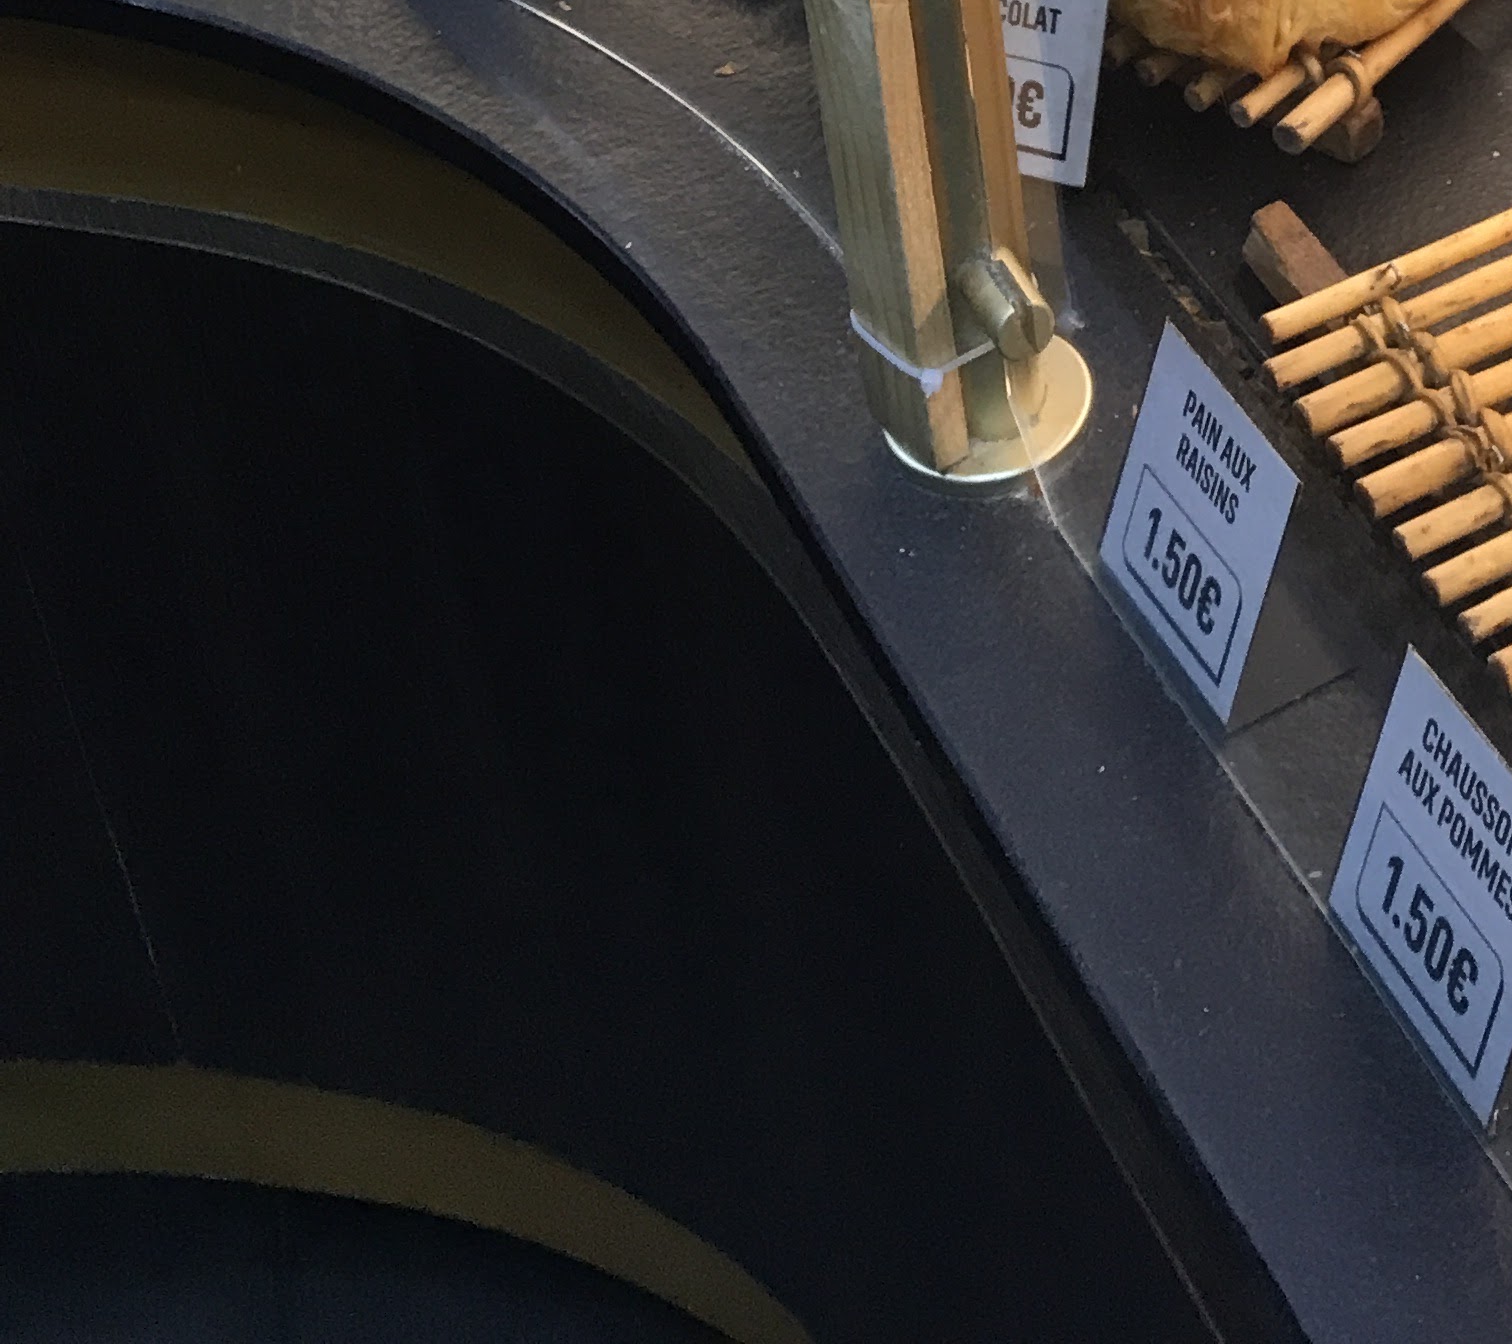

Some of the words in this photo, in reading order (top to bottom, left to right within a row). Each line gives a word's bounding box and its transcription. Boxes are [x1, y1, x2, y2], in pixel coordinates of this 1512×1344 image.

[1176, 433, 1240, 525] RAISINS
[1183, 389, 1223, 453] PAIN
[1222, 445, 1257, 493] AUX
[1143, 507, 1222, 636] 1.50€
[1398, 749, 1440, 816] AUX
[1381, 855, 1479, 1017] 1.50€
